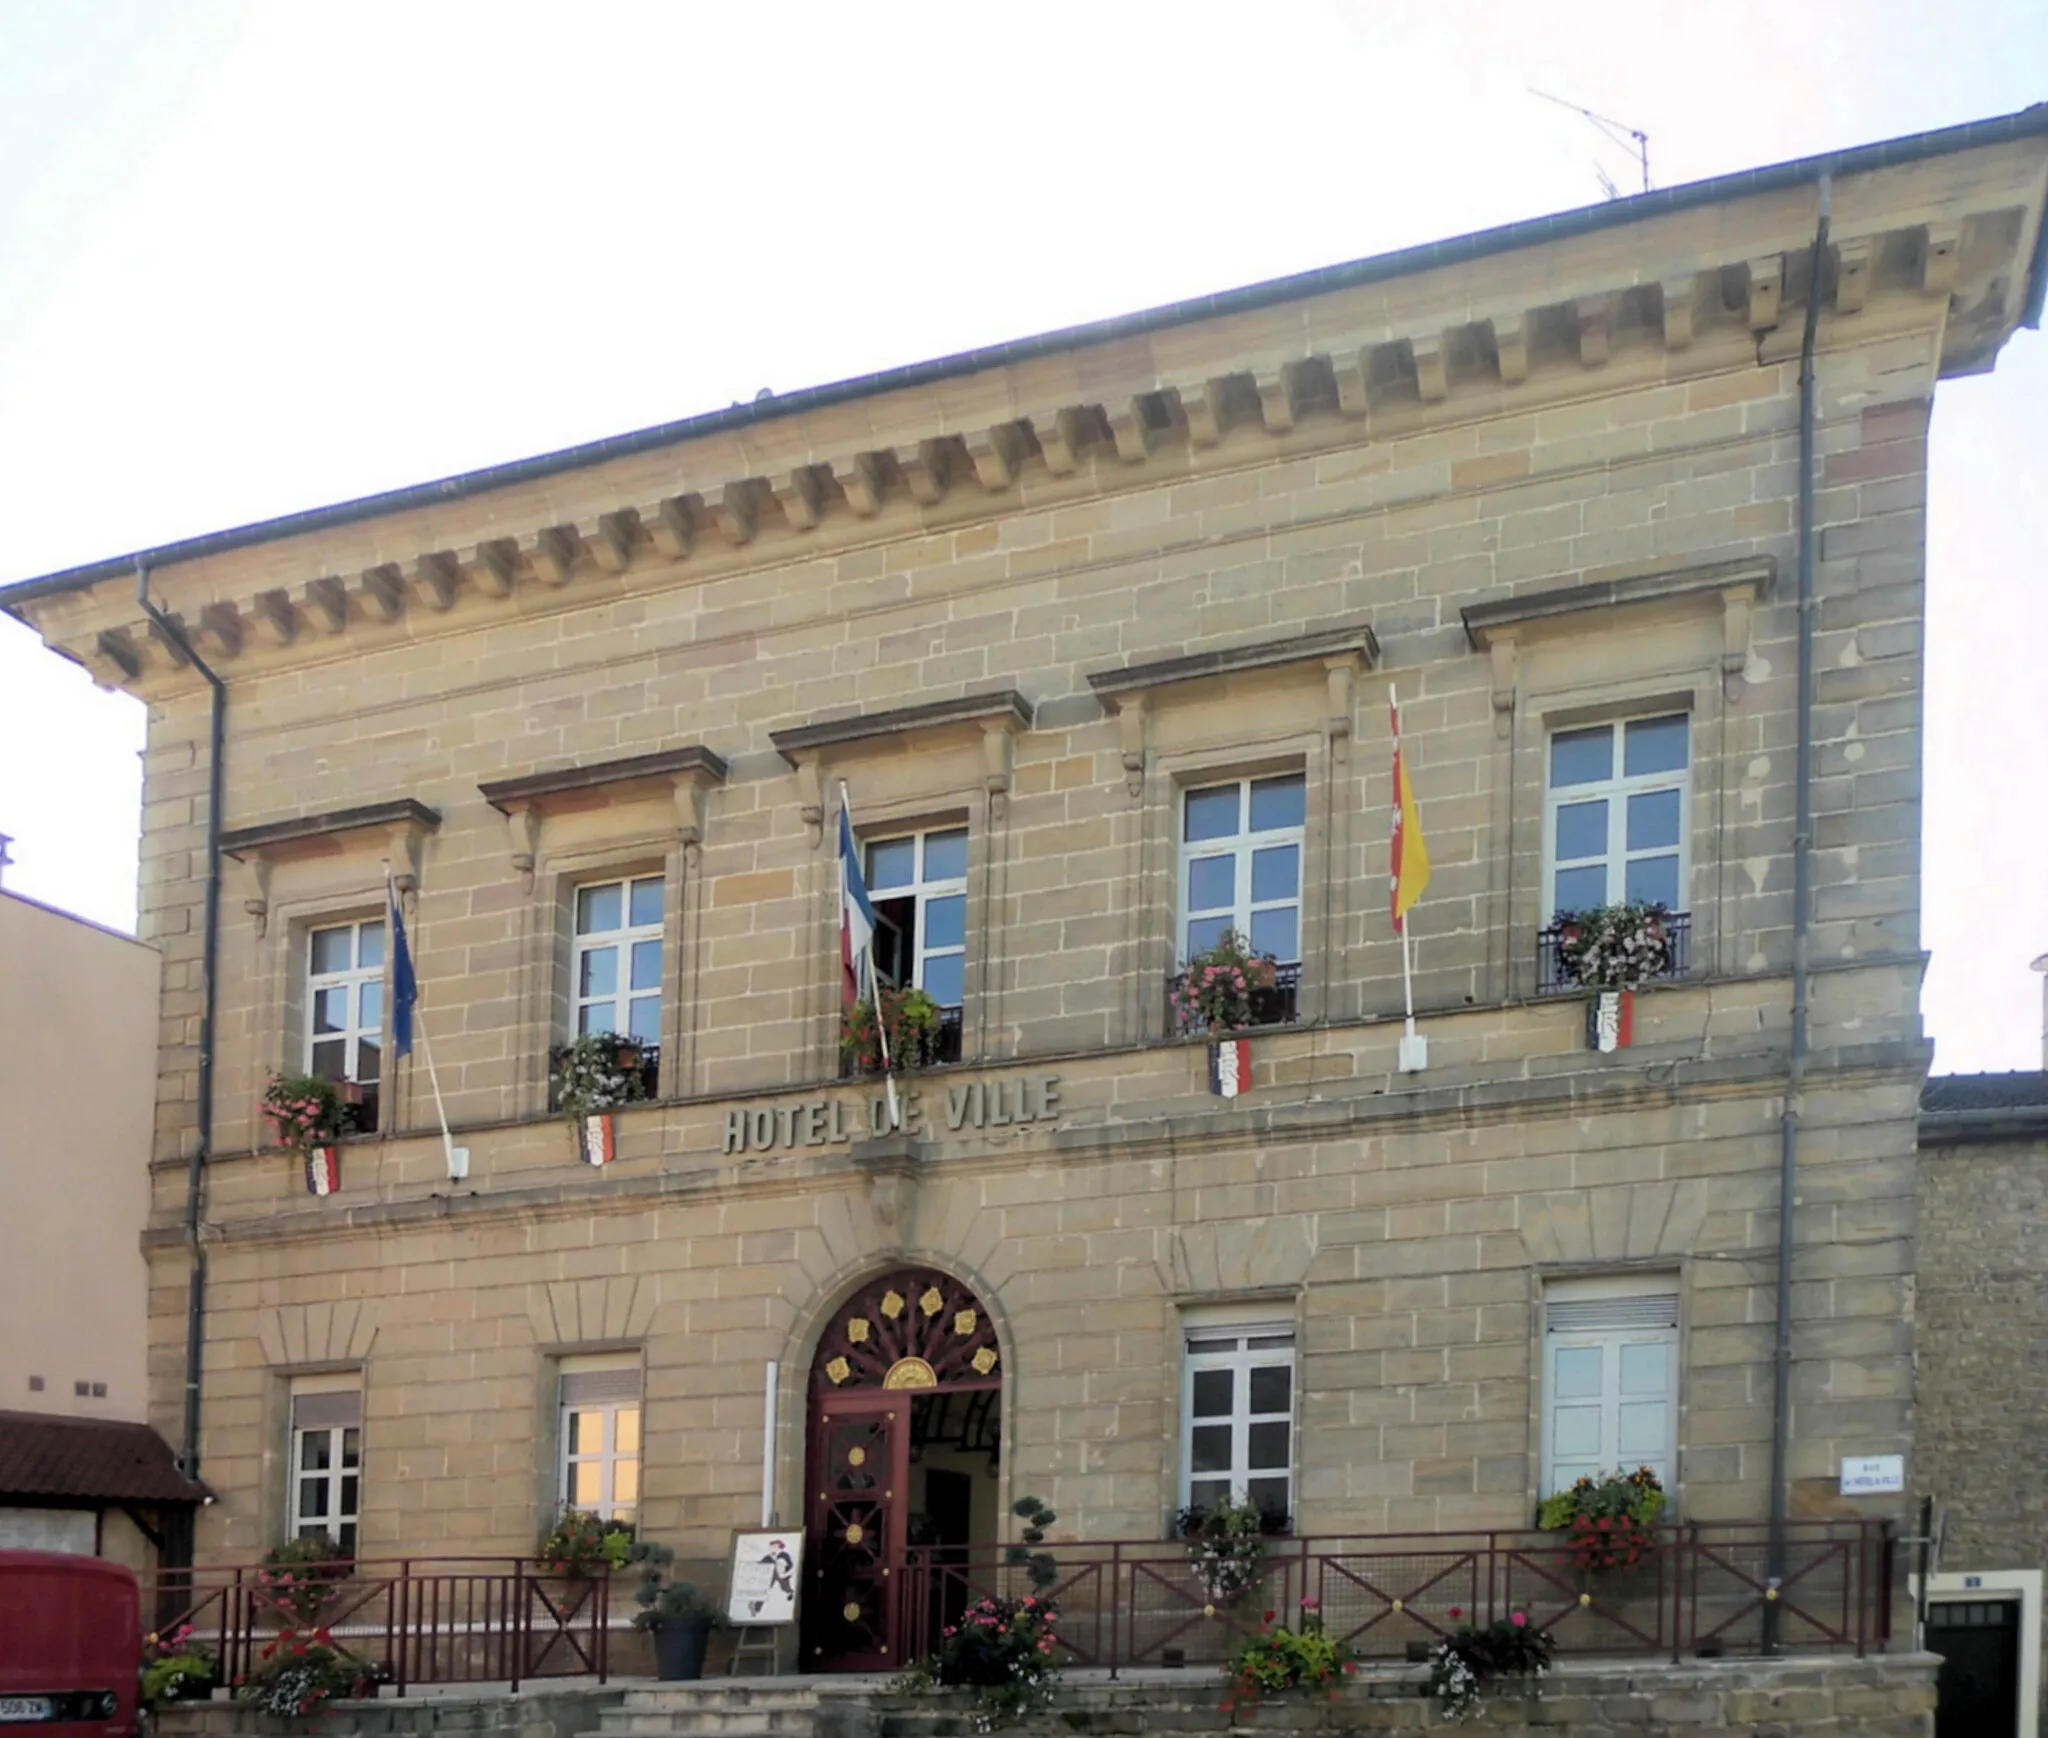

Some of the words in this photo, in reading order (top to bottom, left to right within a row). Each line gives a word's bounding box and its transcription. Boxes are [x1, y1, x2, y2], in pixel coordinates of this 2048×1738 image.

[723, 1100, 849, 1155] HOTEL
[870, 1090, 921, 1140] DE
[943, 1074, 1061, 1131] VILLE
